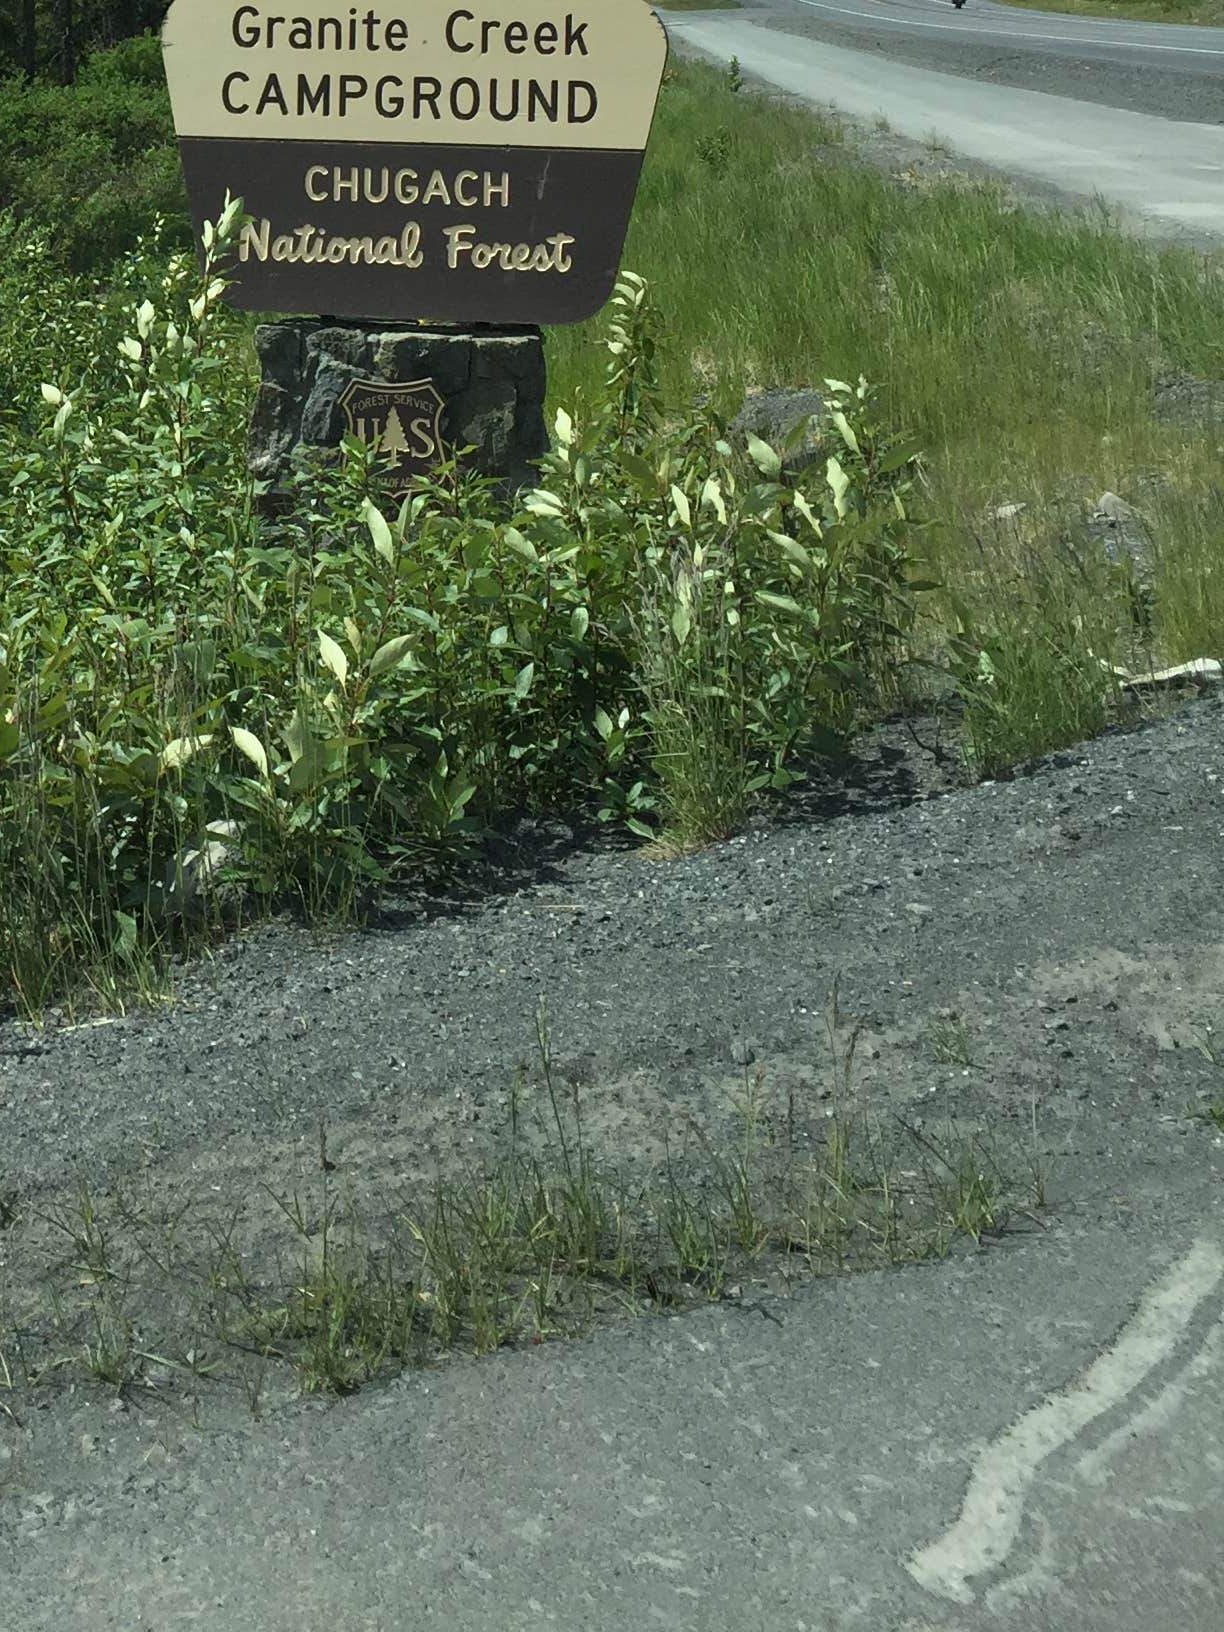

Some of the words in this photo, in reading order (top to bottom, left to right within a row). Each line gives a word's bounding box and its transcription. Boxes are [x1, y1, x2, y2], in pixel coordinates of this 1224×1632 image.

[232, 5, 409, 51] Granite
[445, 10, 589, 56] Creek
[222, 72, 598, 124] CAMPGROUND
[305, 166, 509, 207] CHUGACH
[239, 219, 424, 269] National
[443, 224, 576, 273] Forest
[352, 394, 390, 415] FOREST
[393, 394, 435, 415] SERVICE
